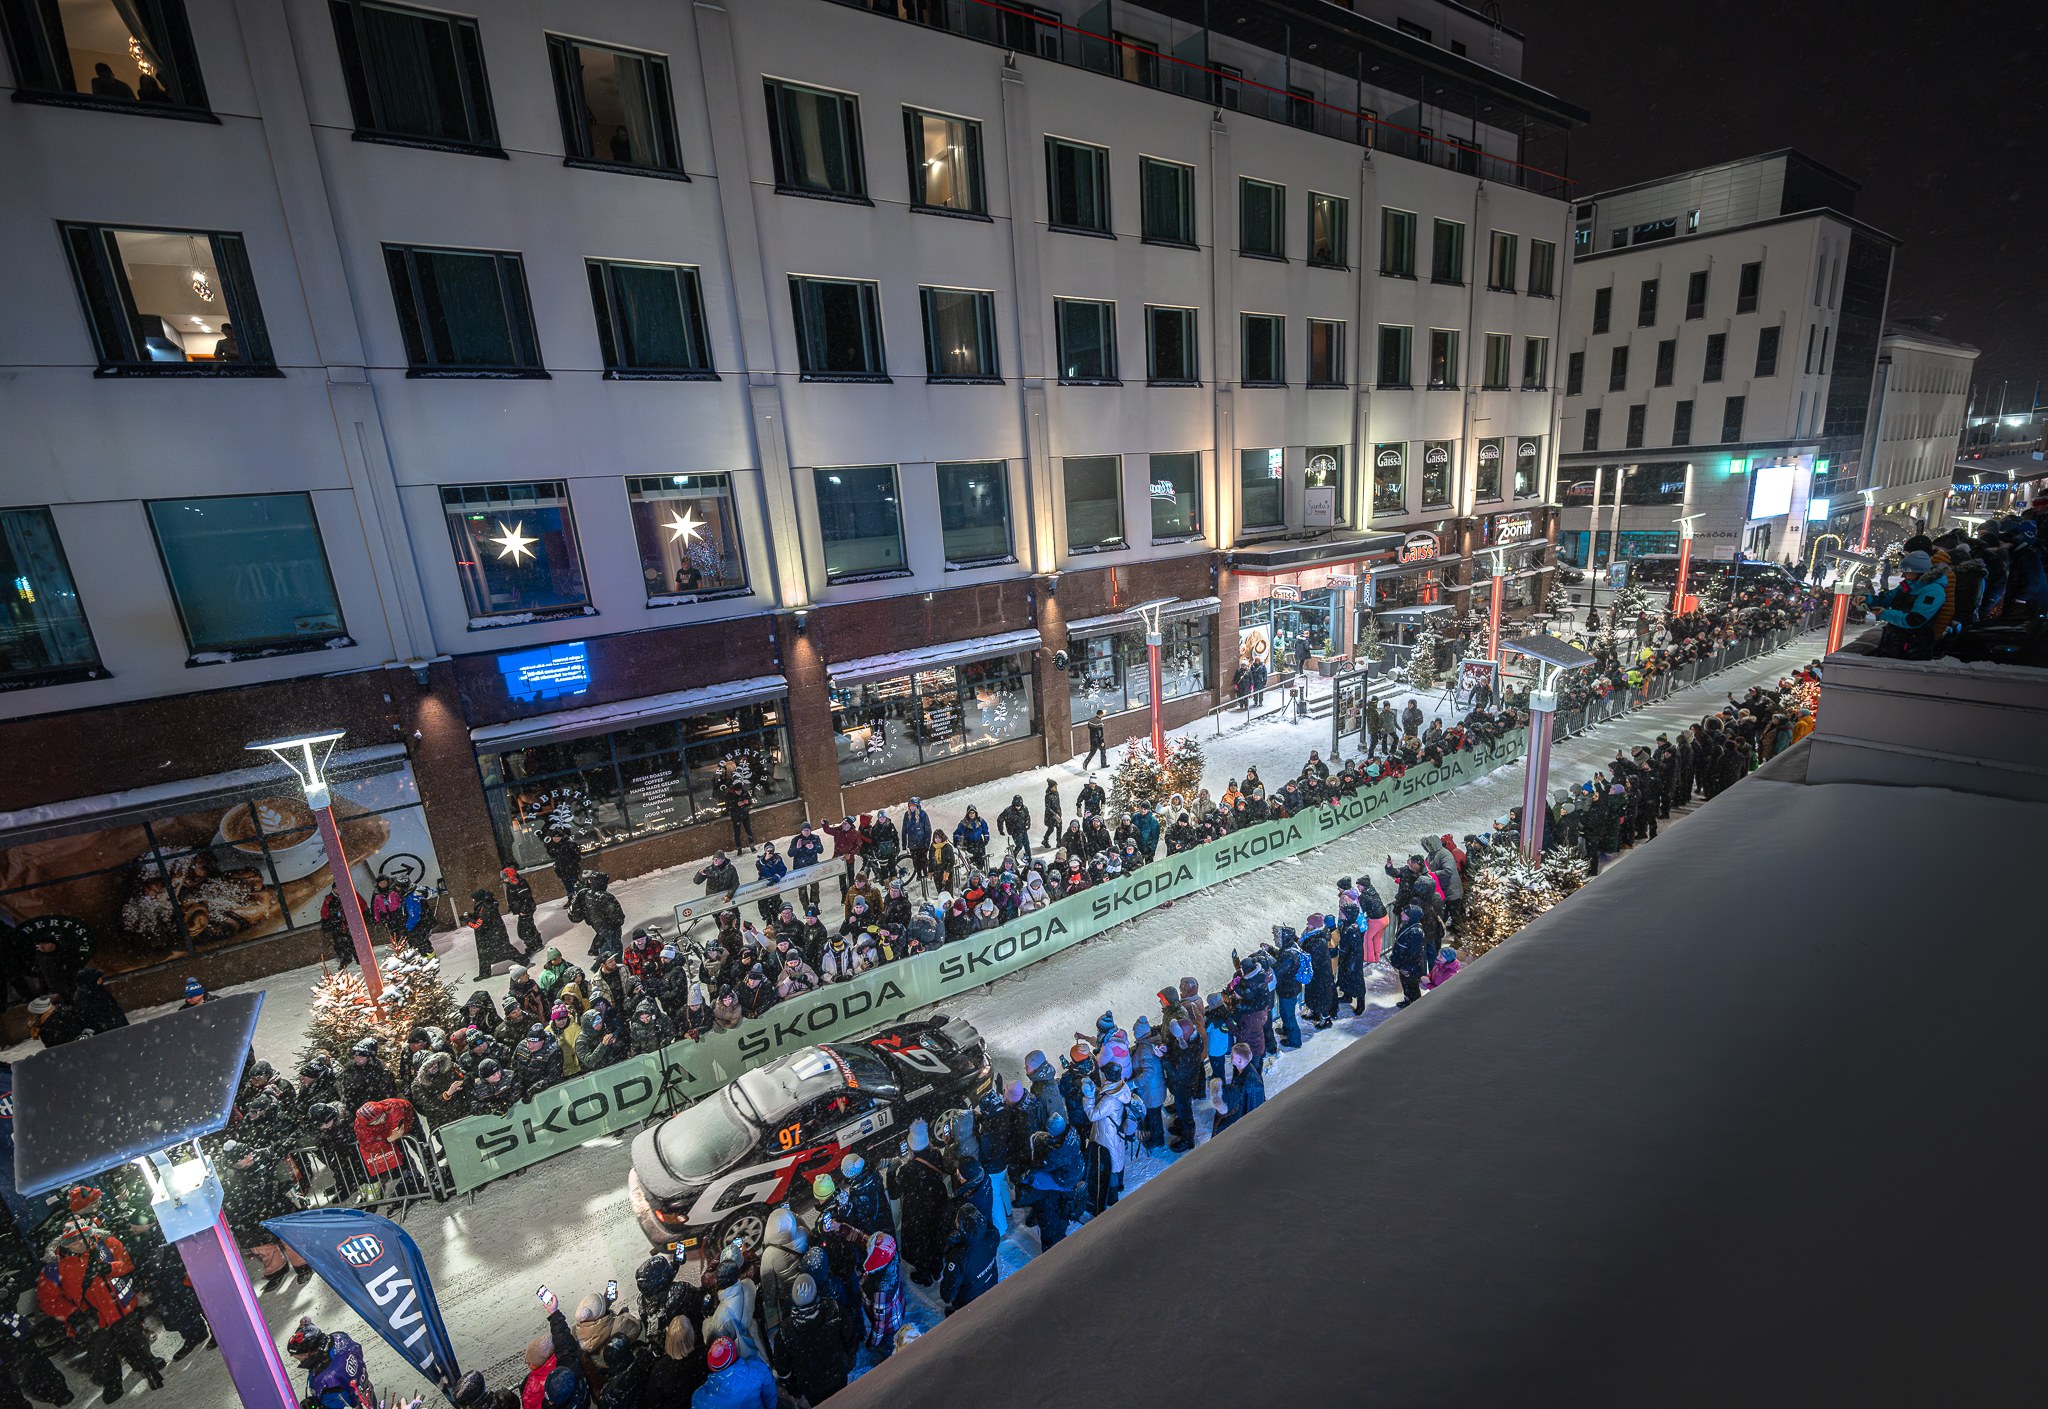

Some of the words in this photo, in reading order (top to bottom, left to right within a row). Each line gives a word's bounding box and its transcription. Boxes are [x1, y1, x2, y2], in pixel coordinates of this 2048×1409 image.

[1378, 451, 1401, 467] Gaissa
[716, 748, 767, 775] ROBERT'S
[632, 775, 649, 783] FRESH
[649, 770, 672, 780] ROASTED
[644, 777, 664, 786] COFFEE
[630, 787, 645, 795] HAND
[642, 787, 670, 797] BREAKFAST
[648, 793, 666, 801] LUNCH
[528, 788, 592, 820] ROBERT'S
[642, 796, 674, 808] CHAMPAGNE
[534, 817, 593, 845] COFEE
[877, 1110, 888, 1127] 97
[779, 1122, 801, 1150] 97
